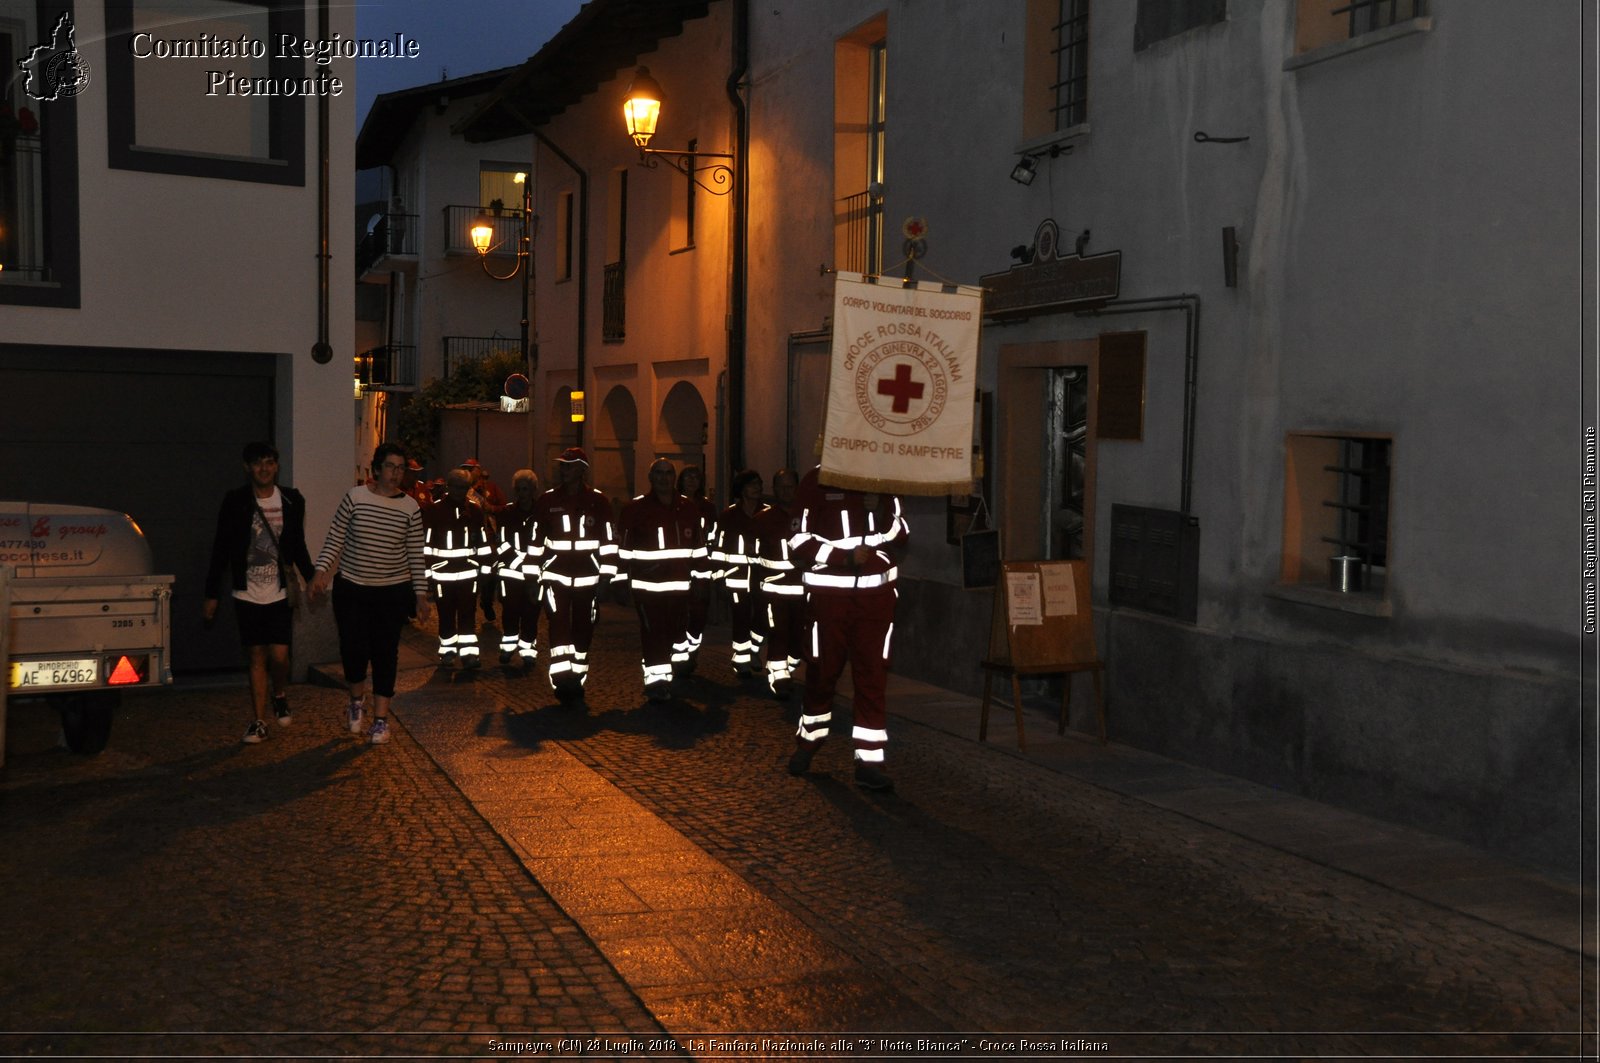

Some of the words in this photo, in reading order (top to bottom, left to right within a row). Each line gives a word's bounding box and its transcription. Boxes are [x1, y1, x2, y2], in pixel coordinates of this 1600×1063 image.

[842, 296, 870, 309] CORPO
[872, 302, 914, 316] VOLONTARI
[914, 308, 927, 318] DEL
[929, 309, 971, 321] SOCCORSO
[844, 331, 875, 371] CROCE
[877, 322, 922, 338] ROSSA
[925, 331, 963, 383] ITALIANA
[871, 352, 881, 363] DI
[882, 344, 925, 358] GINEVRA
[925, 356, 938, 371] 22
[856, 363, 886, 429] CONVENZIONE
[930, 373, 946, 415] AGOSTO
[911, 415, 933, 431] 1864
[831, 437, 878, 452] GRUPPO
[883, 442, 894, 455] DI
[898, 444, 963, 460] SAMPEYRE
[59, 523, 108, 540] group
[38, 662, 79, 671] RIMORCHIO
[23, 671, 39, 685] AE
[52, 669, 94, 683] 64962
